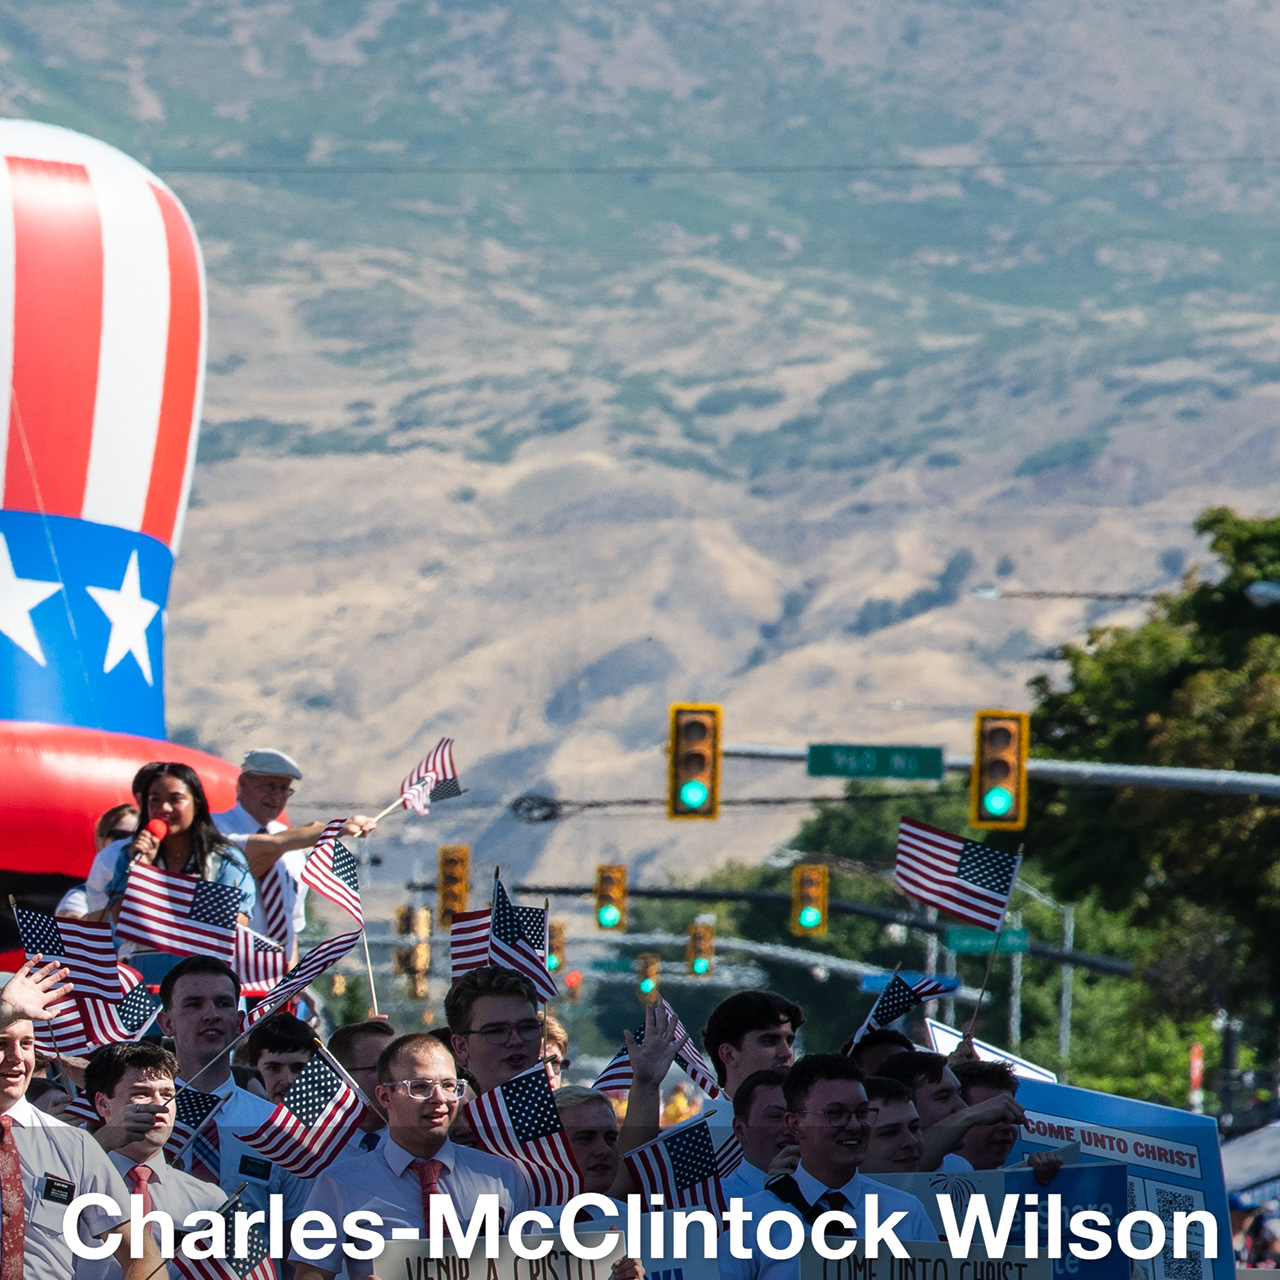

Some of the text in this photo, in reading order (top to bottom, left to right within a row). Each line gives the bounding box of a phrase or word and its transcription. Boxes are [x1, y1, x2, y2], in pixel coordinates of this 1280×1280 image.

[1025, 1118, 1197, 1169] COME UNTO CHRIST
